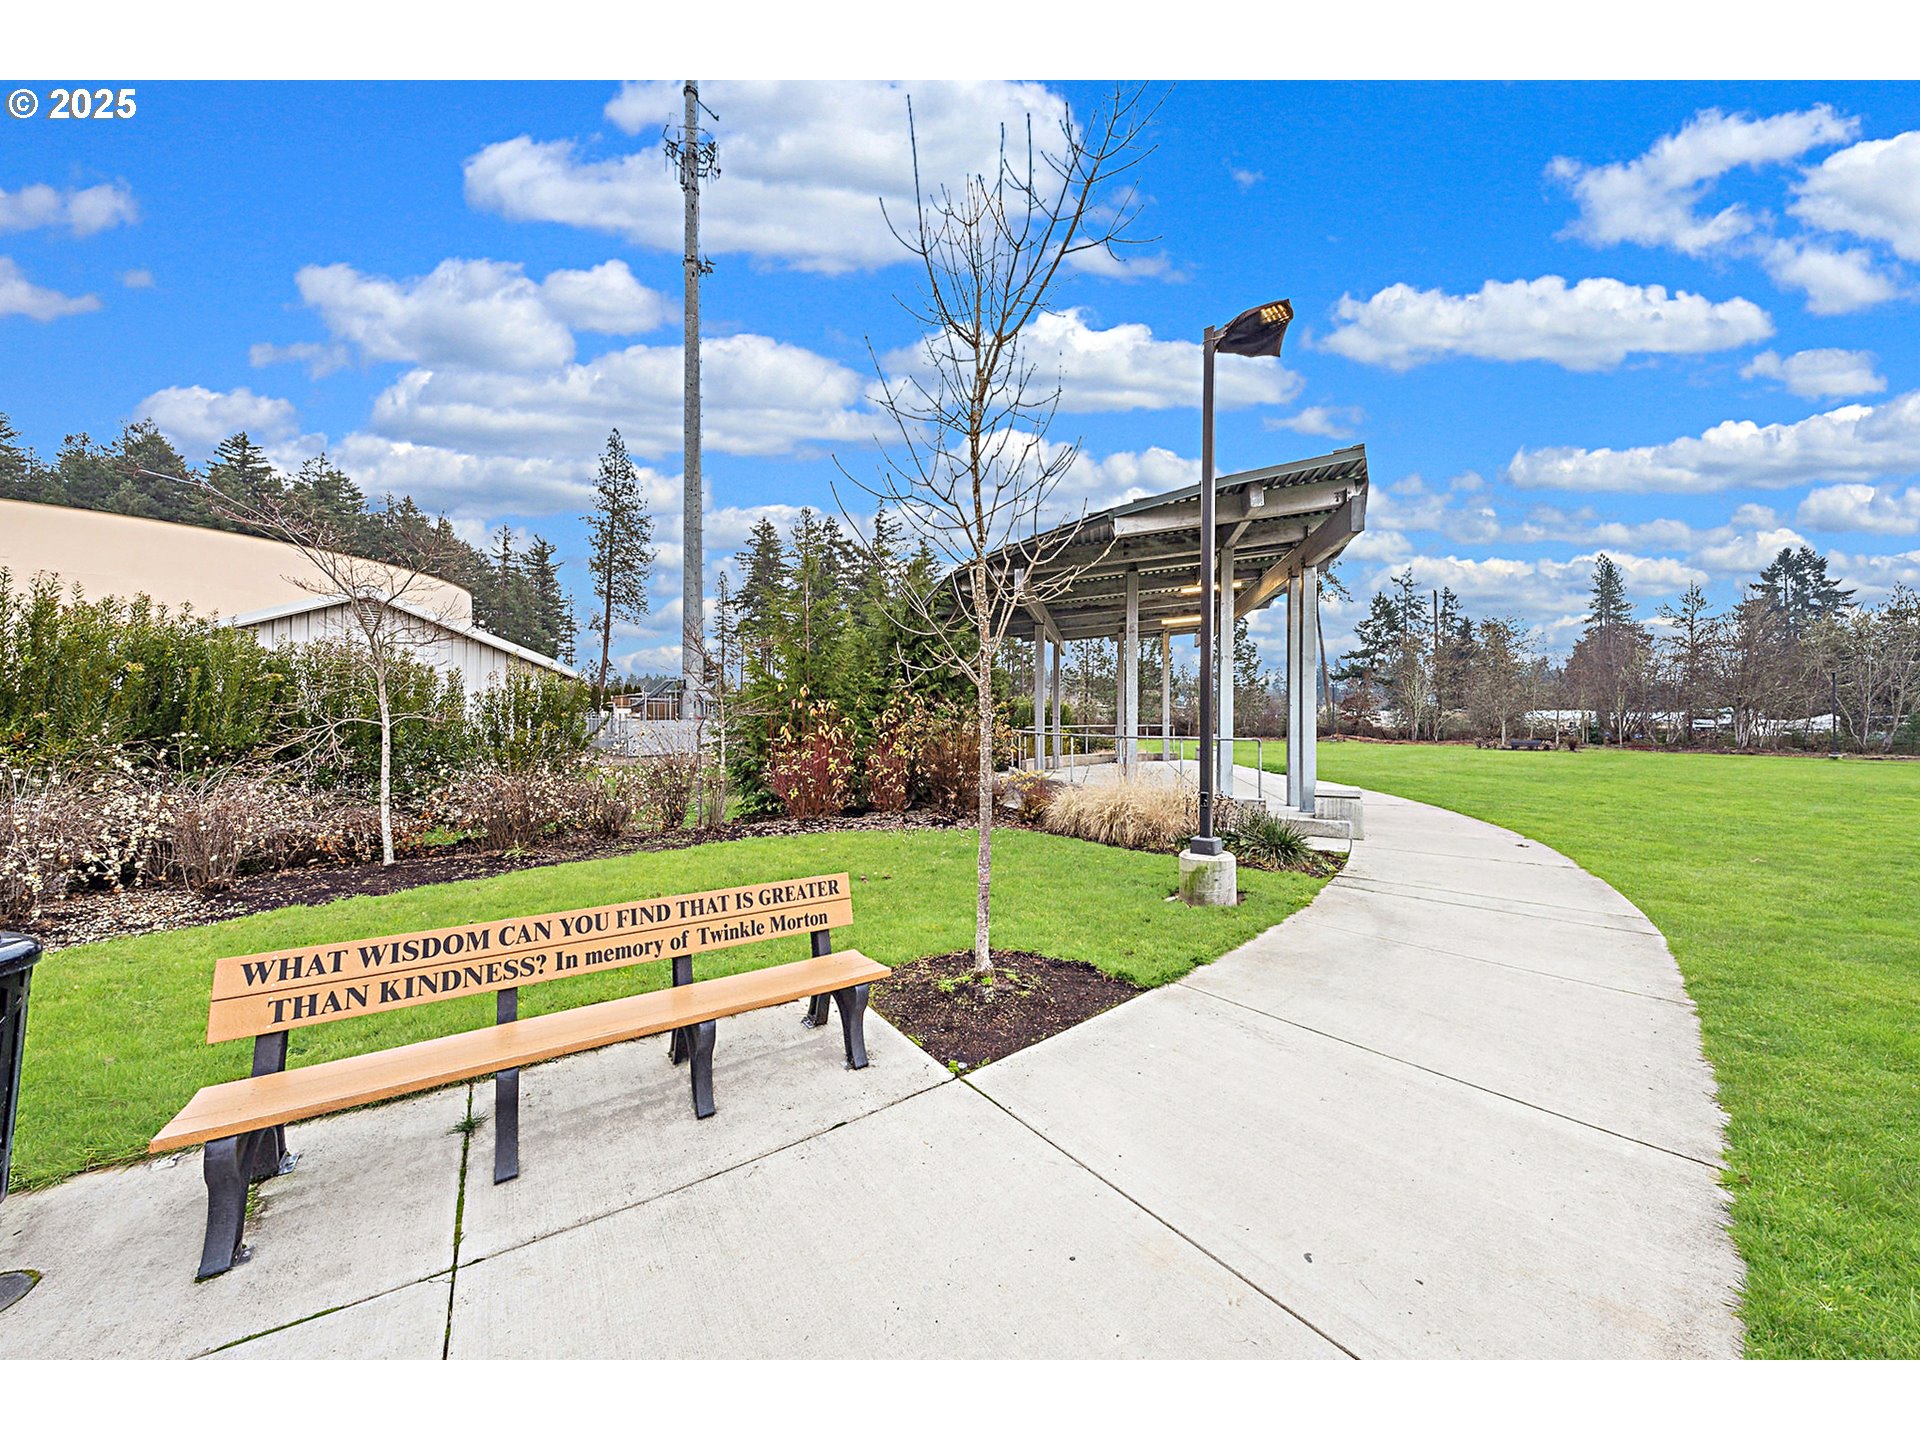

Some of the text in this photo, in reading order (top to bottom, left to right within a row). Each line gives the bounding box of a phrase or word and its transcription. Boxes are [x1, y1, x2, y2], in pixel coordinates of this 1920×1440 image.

[241, 879, 840, 987] WHAT WISDOM CAN YOU FIND THAT IS GREATER
[267, 912, 828, 1024] THAN KINDNESS? In memory of Twinkle Morton
